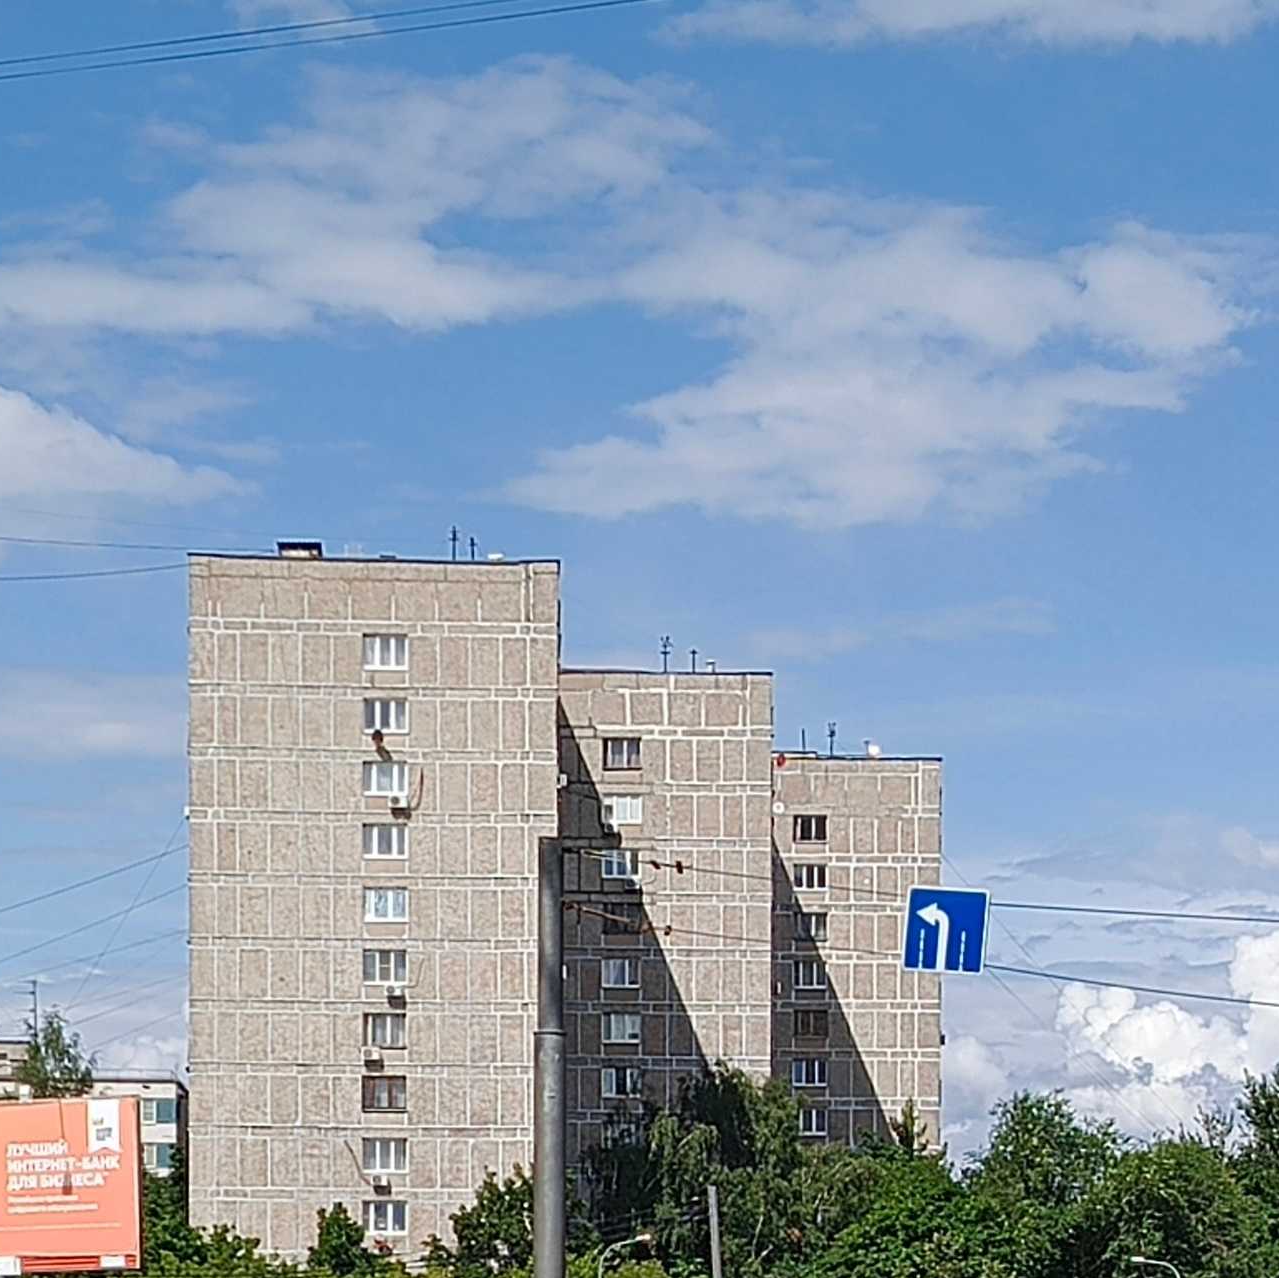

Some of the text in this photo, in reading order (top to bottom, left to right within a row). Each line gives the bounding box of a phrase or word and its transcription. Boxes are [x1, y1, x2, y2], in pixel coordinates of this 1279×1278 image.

[6, 1138, 68, 1157] ЛУЧШИЙ
[6, 1155, 120, 1173] ИНТЕРНЕТ-БАНК
[6, 1174, 37, 1191] ДЛЯ
